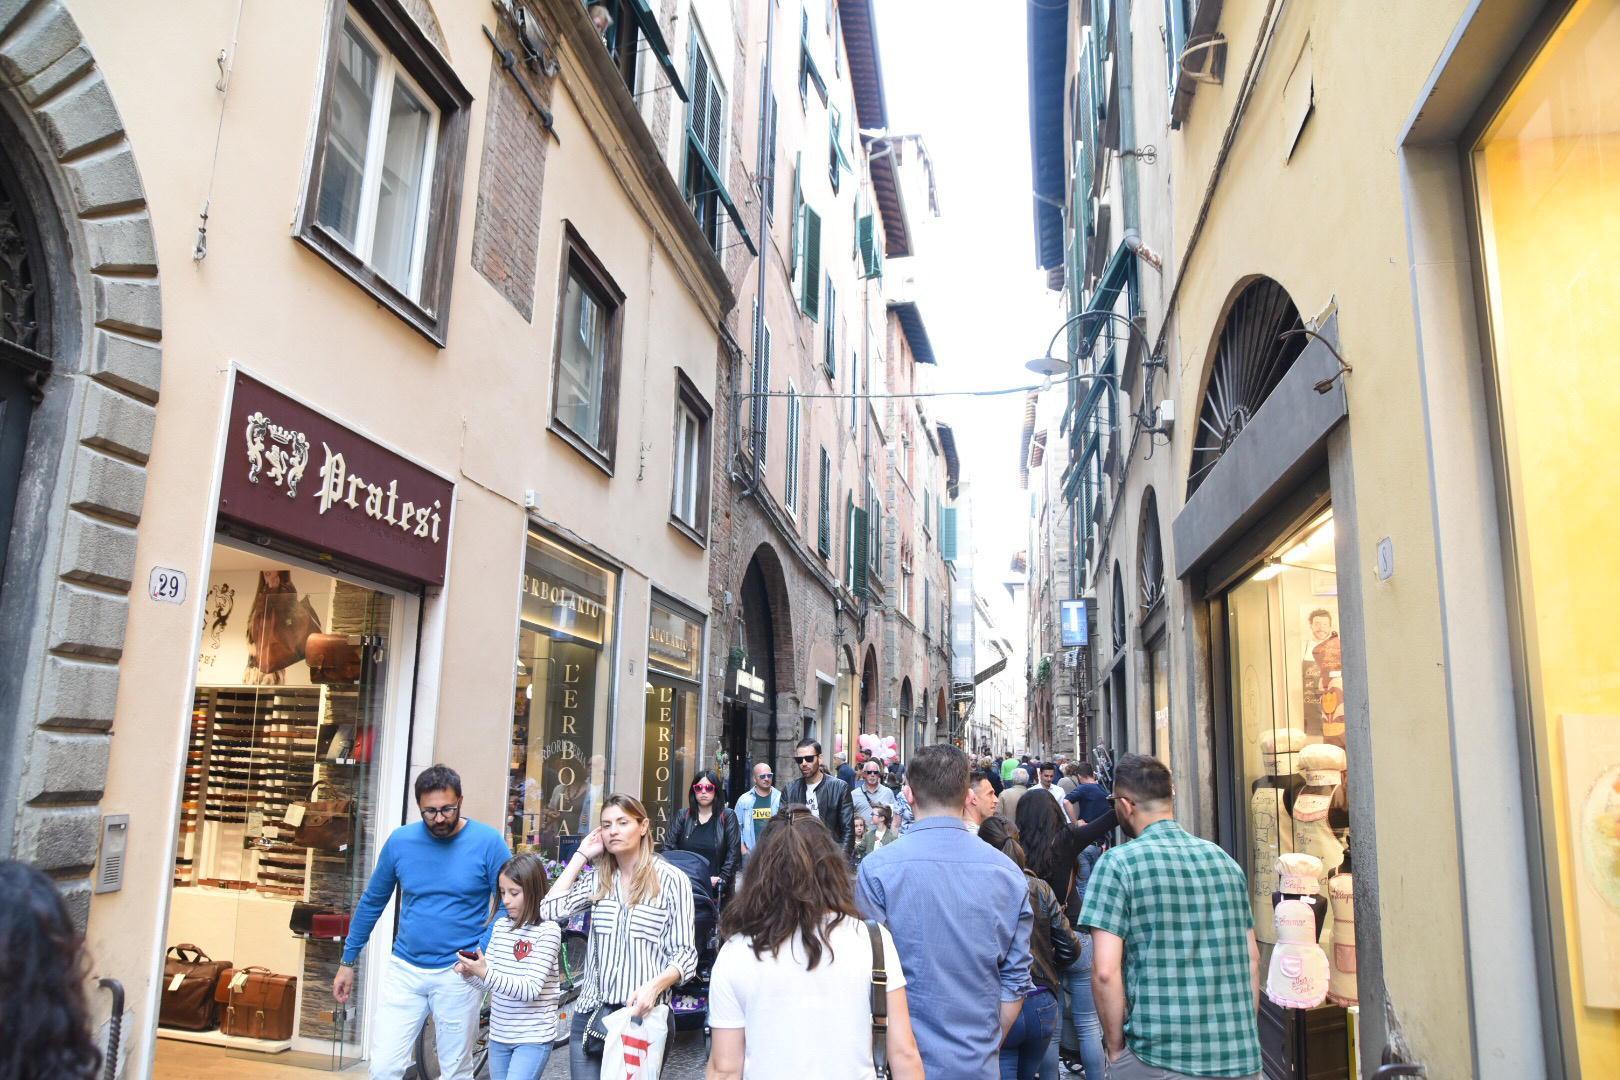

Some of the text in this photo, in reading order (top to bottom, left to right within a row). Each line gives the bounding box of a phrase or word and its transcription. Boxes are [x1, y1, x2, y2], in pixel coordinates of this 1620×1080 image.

[314, 442, 441, 543] Pratesi
[158, 573, 179, 598] 29
[557, 663, 580, 862] L'ERBOLA
[655, 687, 673, 845] L'ERBOLAR
